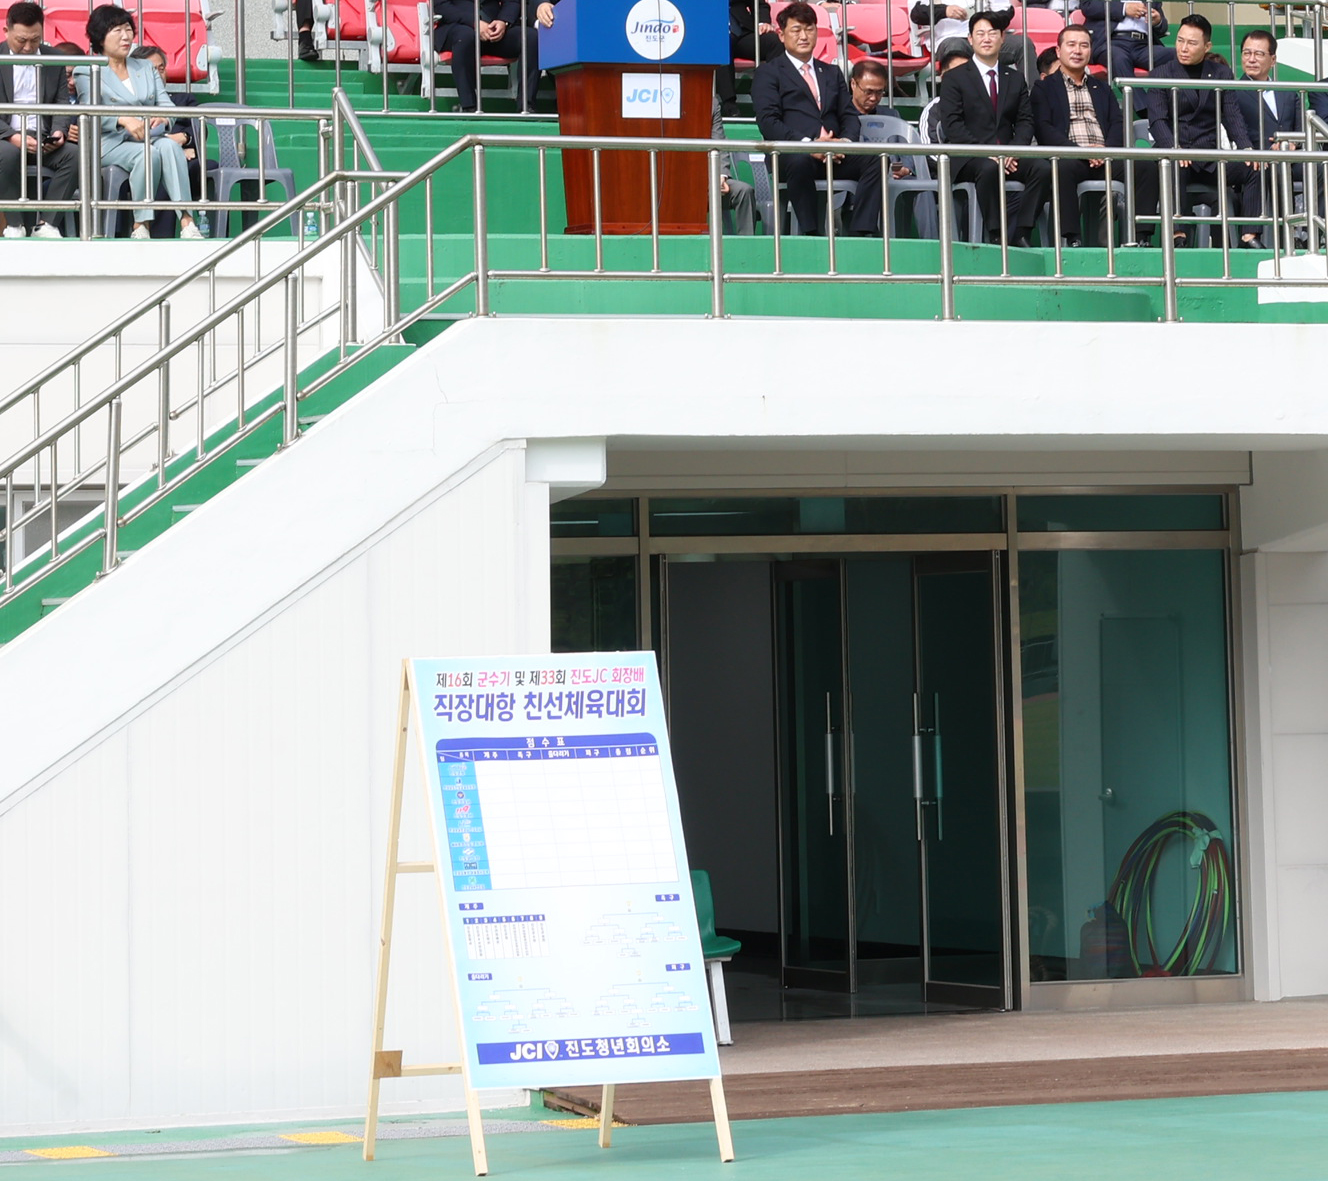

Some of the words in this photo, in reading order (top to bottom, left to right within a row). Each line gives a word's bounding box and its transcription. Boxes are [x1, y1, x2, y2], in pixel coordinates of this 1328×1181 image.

[631, 21, 671, 35] Jindo
[626, 88, 658, 103] JCI
[436, 672, 473, 688] 제16회
[477, 671, 510, 687] 군수기
[515, 671, 525, 686] 및
[529, 669, 566, 686] 제33회
[570, 668, 608, 685] 진도JC
[611, 667, 645, 683] 회장배
[433, 692, 516, 722] 직장대항
[523, 688, 646, 720] 친선체육대회
[510, 1043, 543, 1060] JCI
[565, 1035, 671, 1057] 진도청년회의소
